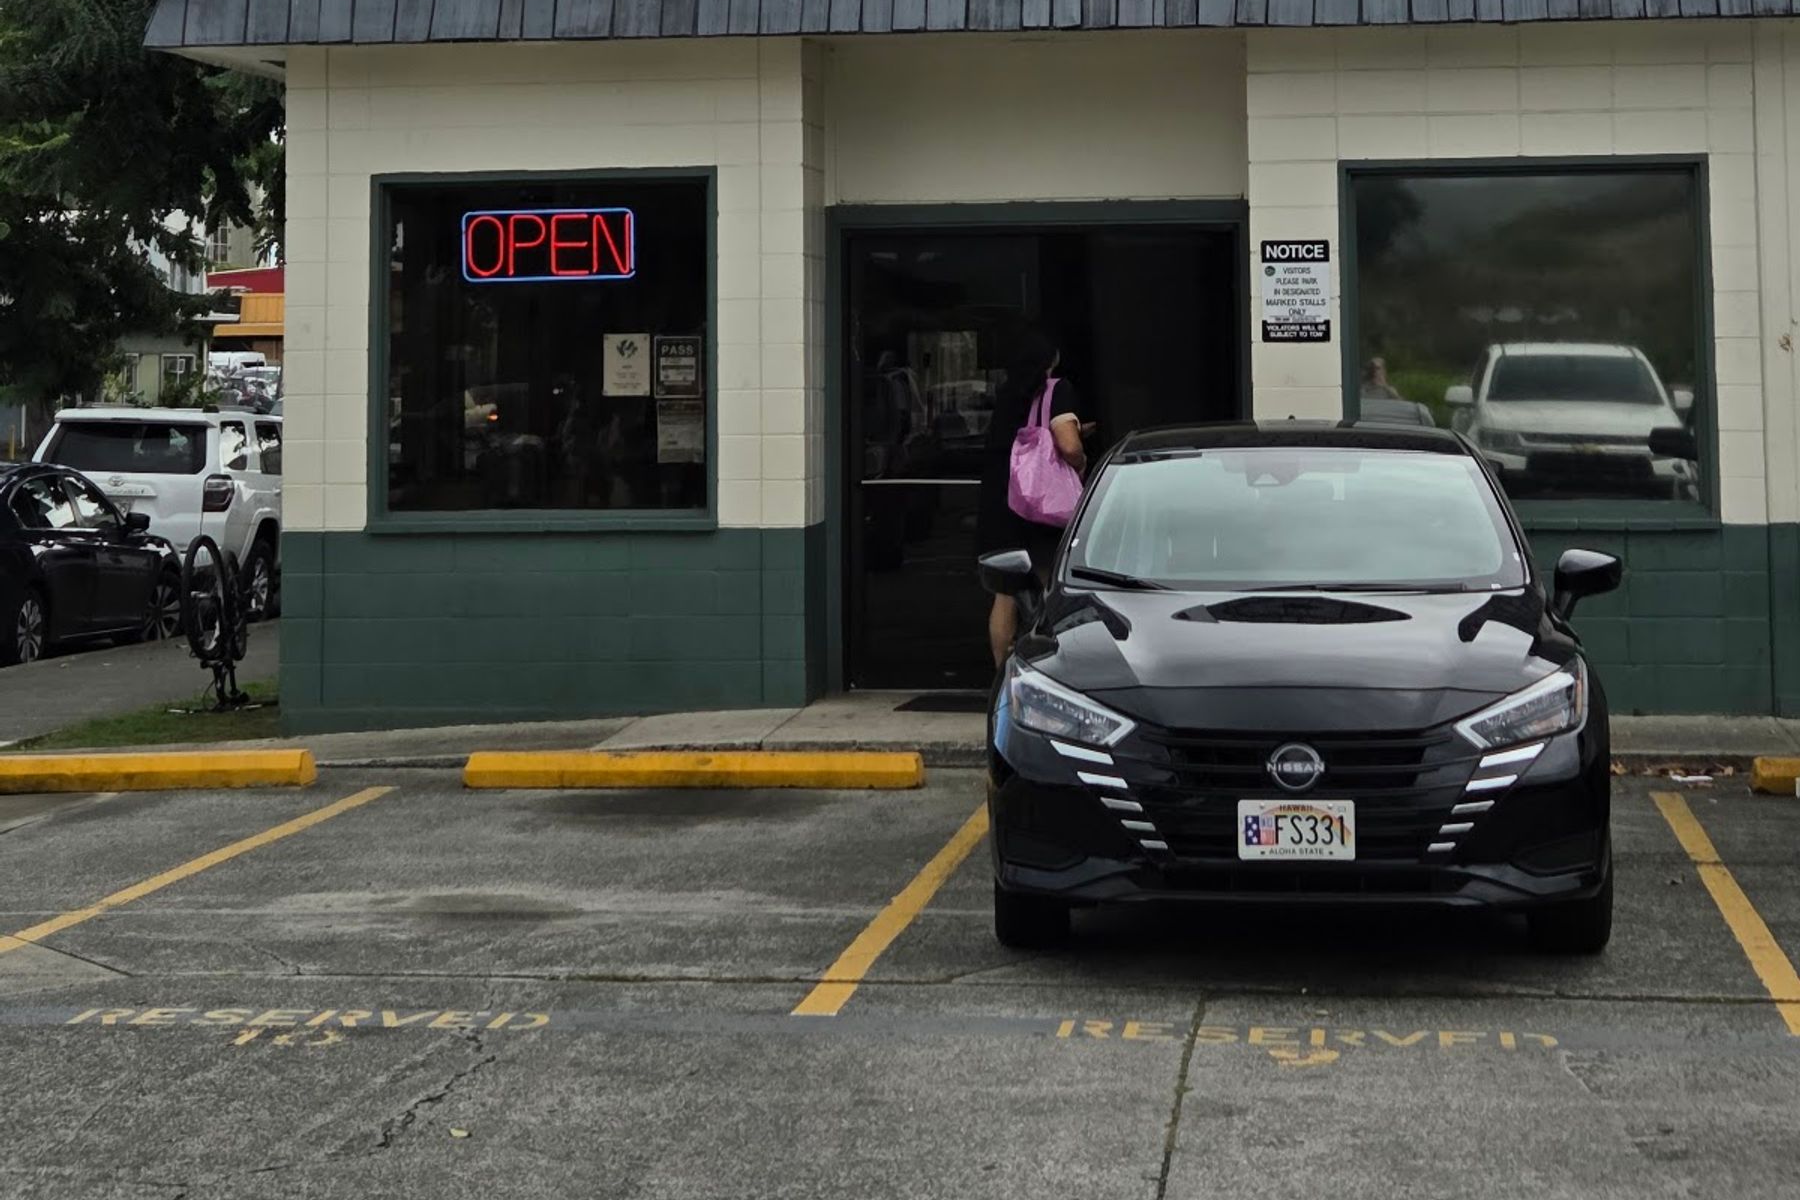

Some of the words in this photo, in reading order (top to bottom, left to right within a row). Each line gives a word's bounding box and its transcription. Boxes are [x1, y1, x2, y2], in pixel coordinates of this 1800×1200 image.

[467, 213, 630, 277] OPEN
[1265, 244, 1325, 259] NOTICE
[1282, 267, 1311, 275] VISITORS
[1282, 288, 1321, 296] DESIGNATED
[1265, 298, 1297, 306] MARKED
[1299, 298, 1326, 306] STALLS
[1288, 307, 1306, 317] ONLY
[661, 344, 694, 356] PASS
[1266, 761, 1325, 773] NISSAN
[1280, 803, 1313, 812] HAWAII
[1274, 814, 1346, 846] FS331
[1269, 847, 1296, 855] ALOHA
[1299, 847, 1324, 855] STATE
[65, 1007, 551, 1030] RESERVED
